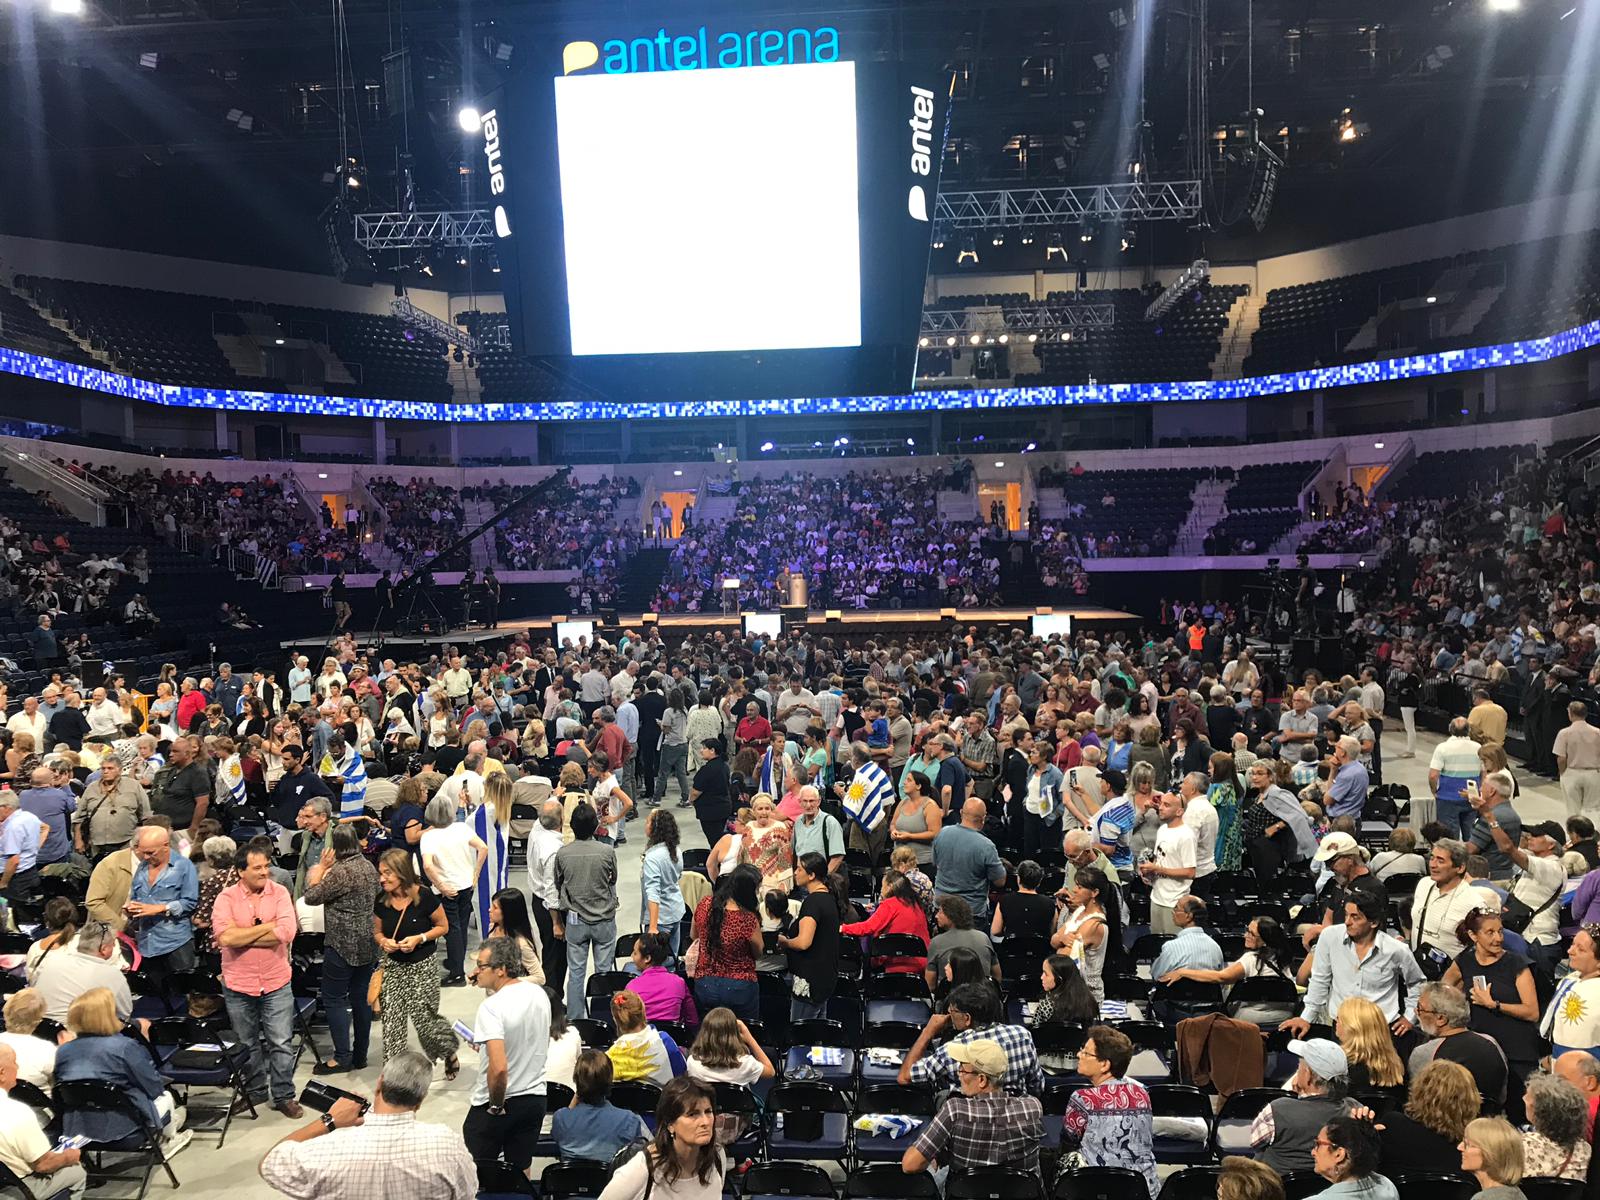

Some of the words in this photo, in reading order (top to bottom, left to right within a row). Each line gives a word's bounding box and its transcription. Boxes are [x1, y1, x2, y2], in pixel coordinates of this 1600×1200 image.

[602, 26, 707, 74] antel
[717, 27, 841, 68] arena
[480, 109, 505, 196] antel
[908, 85, 935, 176] antel
